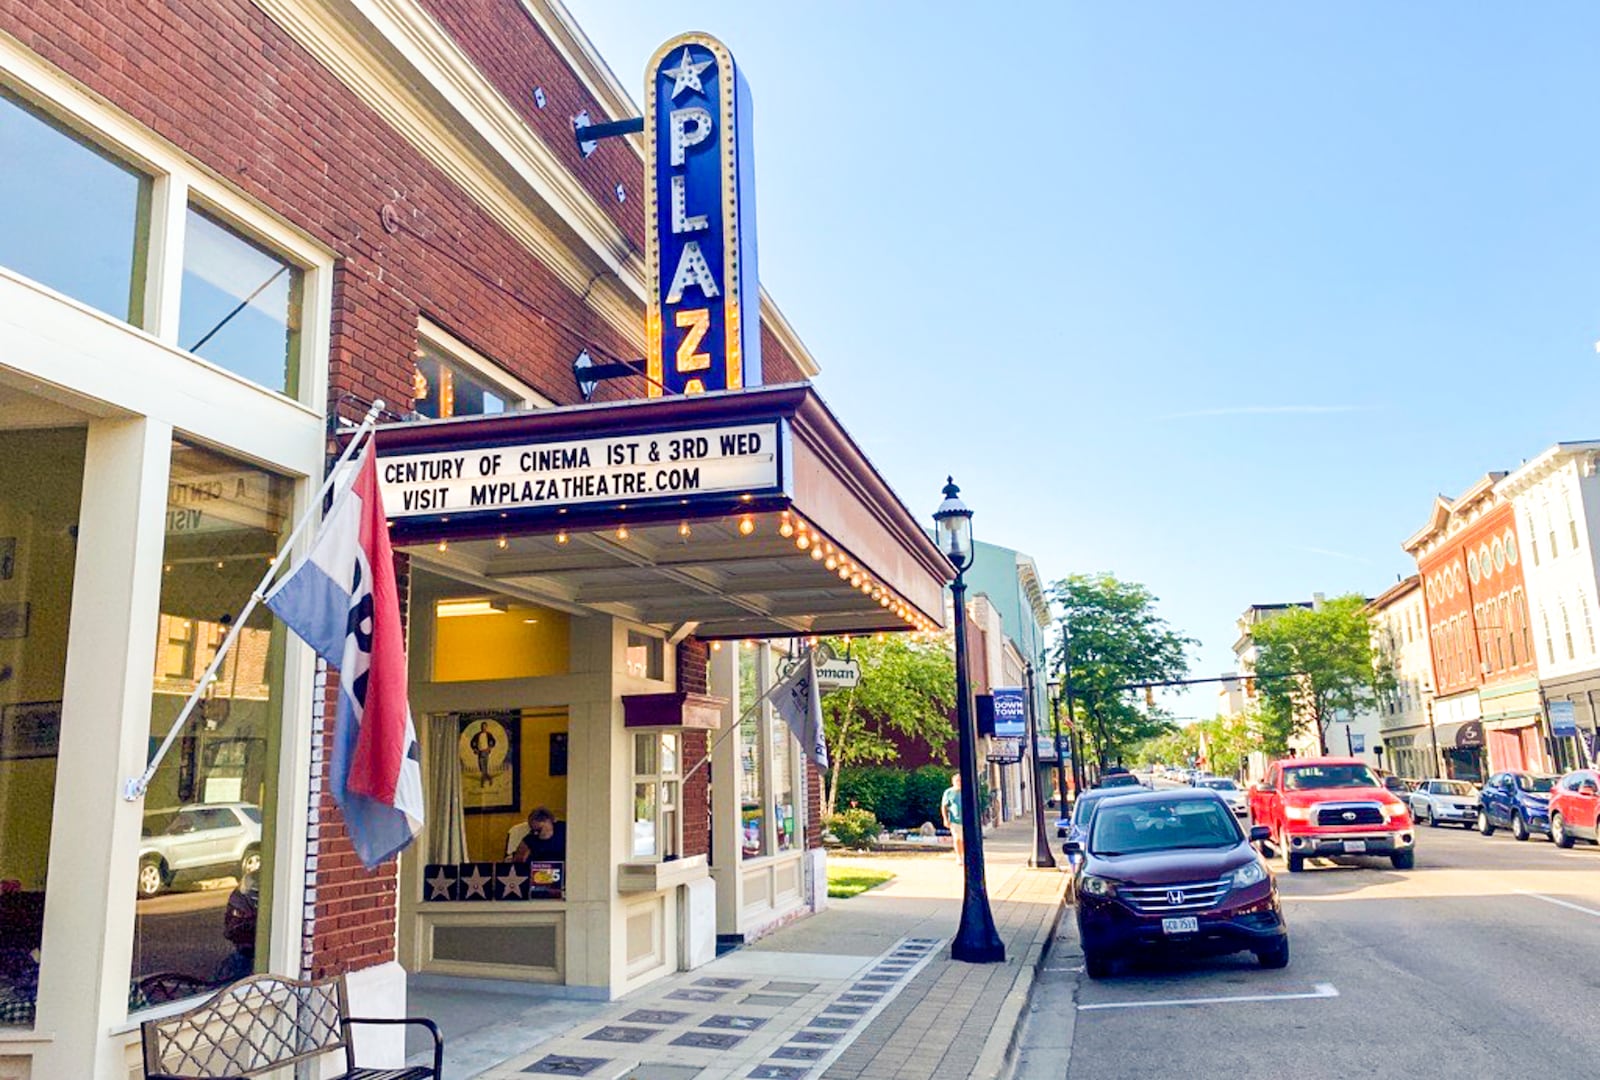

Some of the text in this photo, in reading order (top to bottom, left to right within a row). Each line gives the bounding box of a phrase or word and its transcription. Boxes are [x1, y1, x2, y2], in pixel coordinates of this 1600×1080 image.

[385, 458, 464, 483] CENTURY
[479, 455, 501, 476] OF
[520, 447, 591, 472] CINEMA
[648, 441, 660, 462] &
[669, 437, 709, 461] 3RD
[720, 433, 761, 456] WED
[403, 467, 699, 510] VISIT MYPLAZATHEATRE.COM
[994, 701, 1023, 710] DOWN
[995, 708, 1024, 716] TOWN
